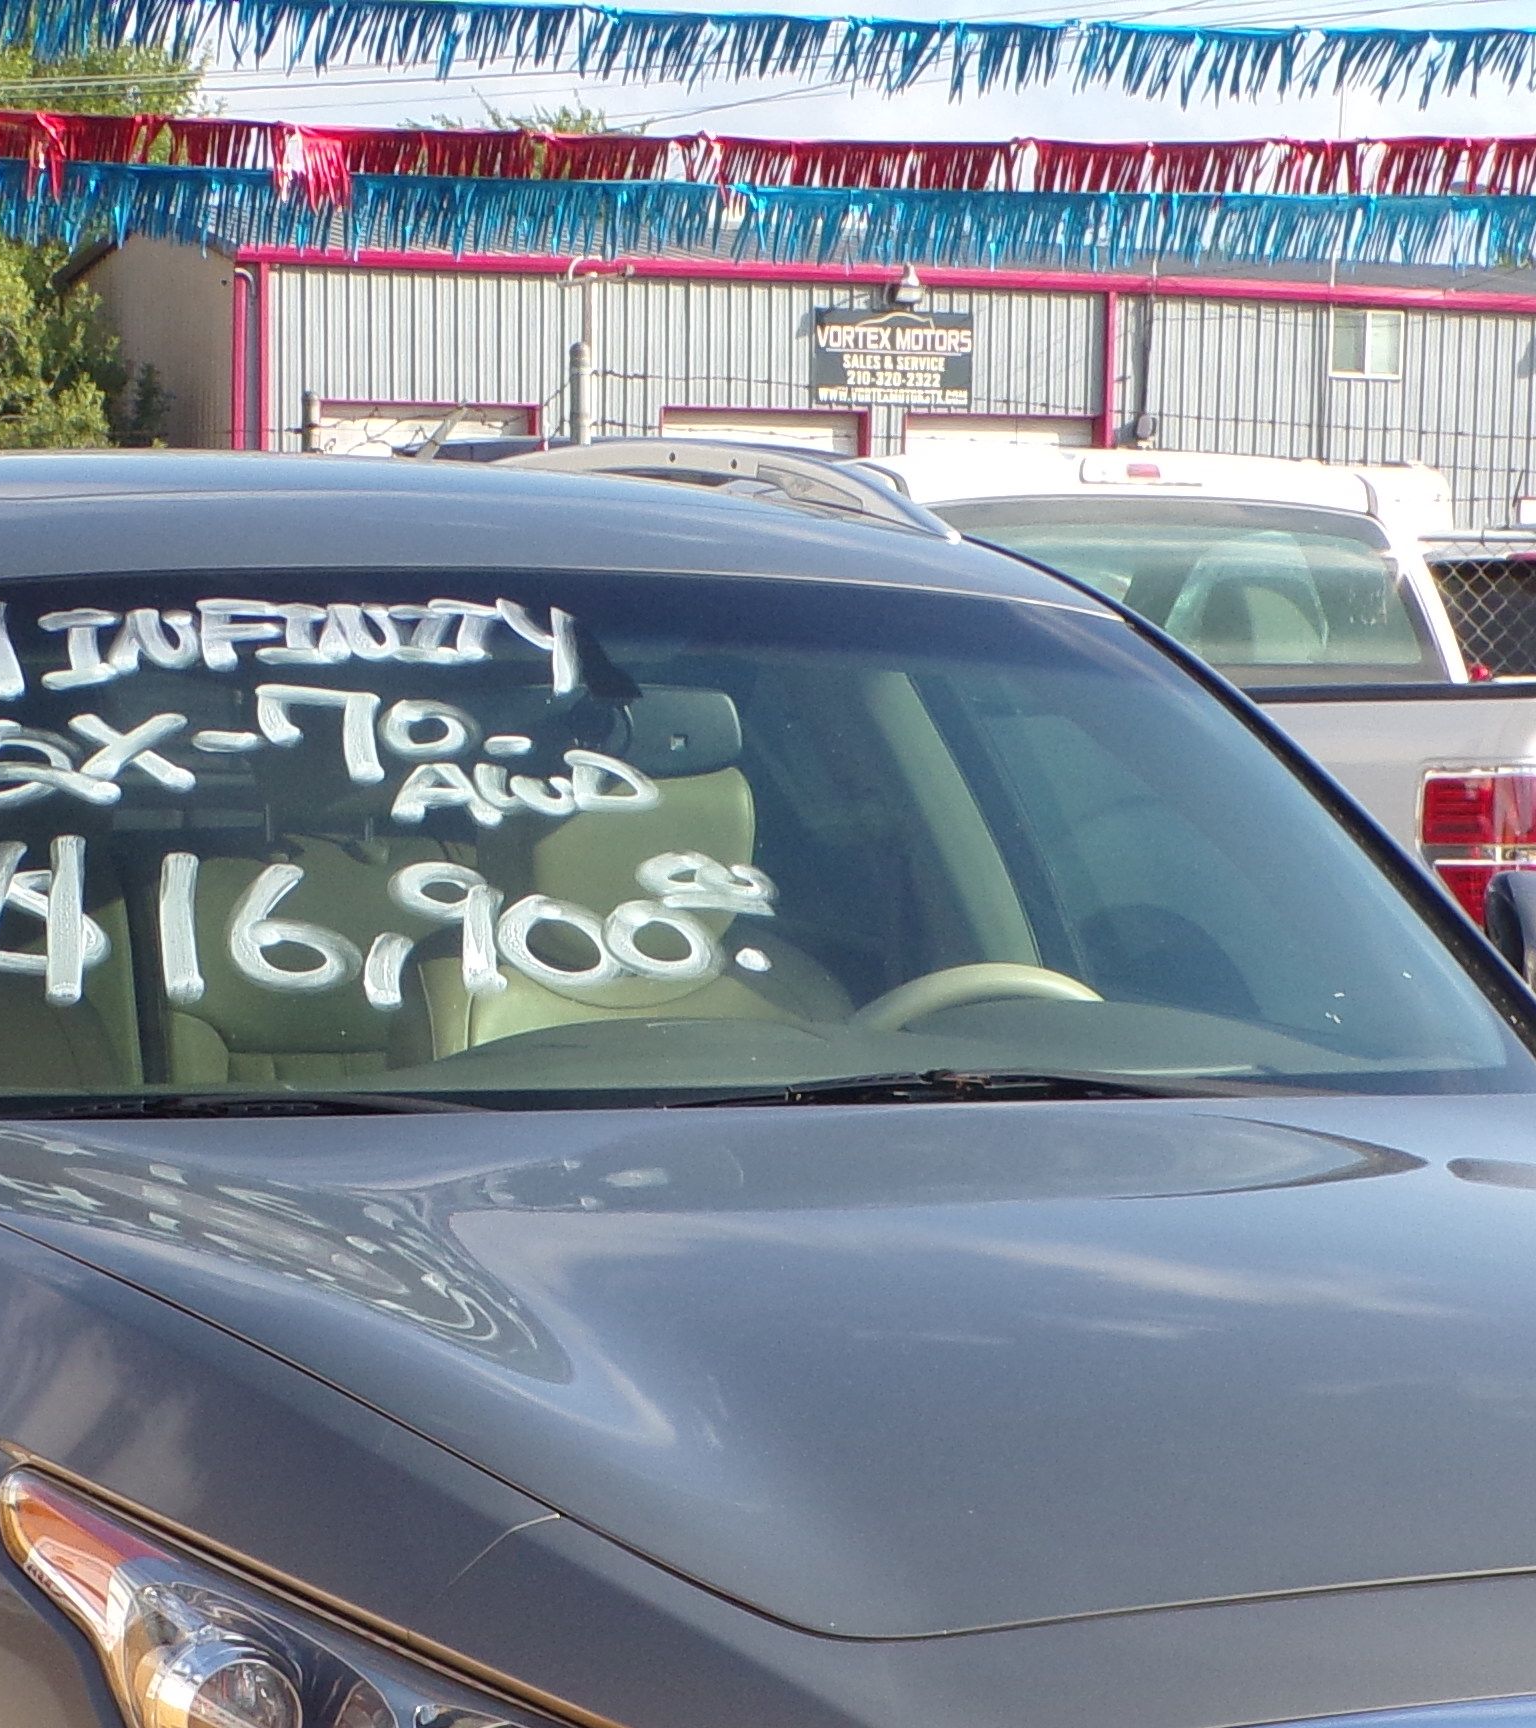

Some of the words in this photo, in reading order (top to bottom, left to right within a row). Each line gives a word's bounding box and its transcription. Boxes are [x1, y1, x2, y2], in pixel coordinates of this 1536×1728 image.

[816, 325, 891, 350] VORTEX
[895, 327, 972, 353] MOTORS
[842, 353, 881, 370] SALES
[883, 355, 894, 370] &
[896, 355, 946, 372] SERVICE
[846, 370, 942, 388] 210-320-2322
[38, 597, 580, 696] INFINITY
[390, 748, 661, 828] AWD
